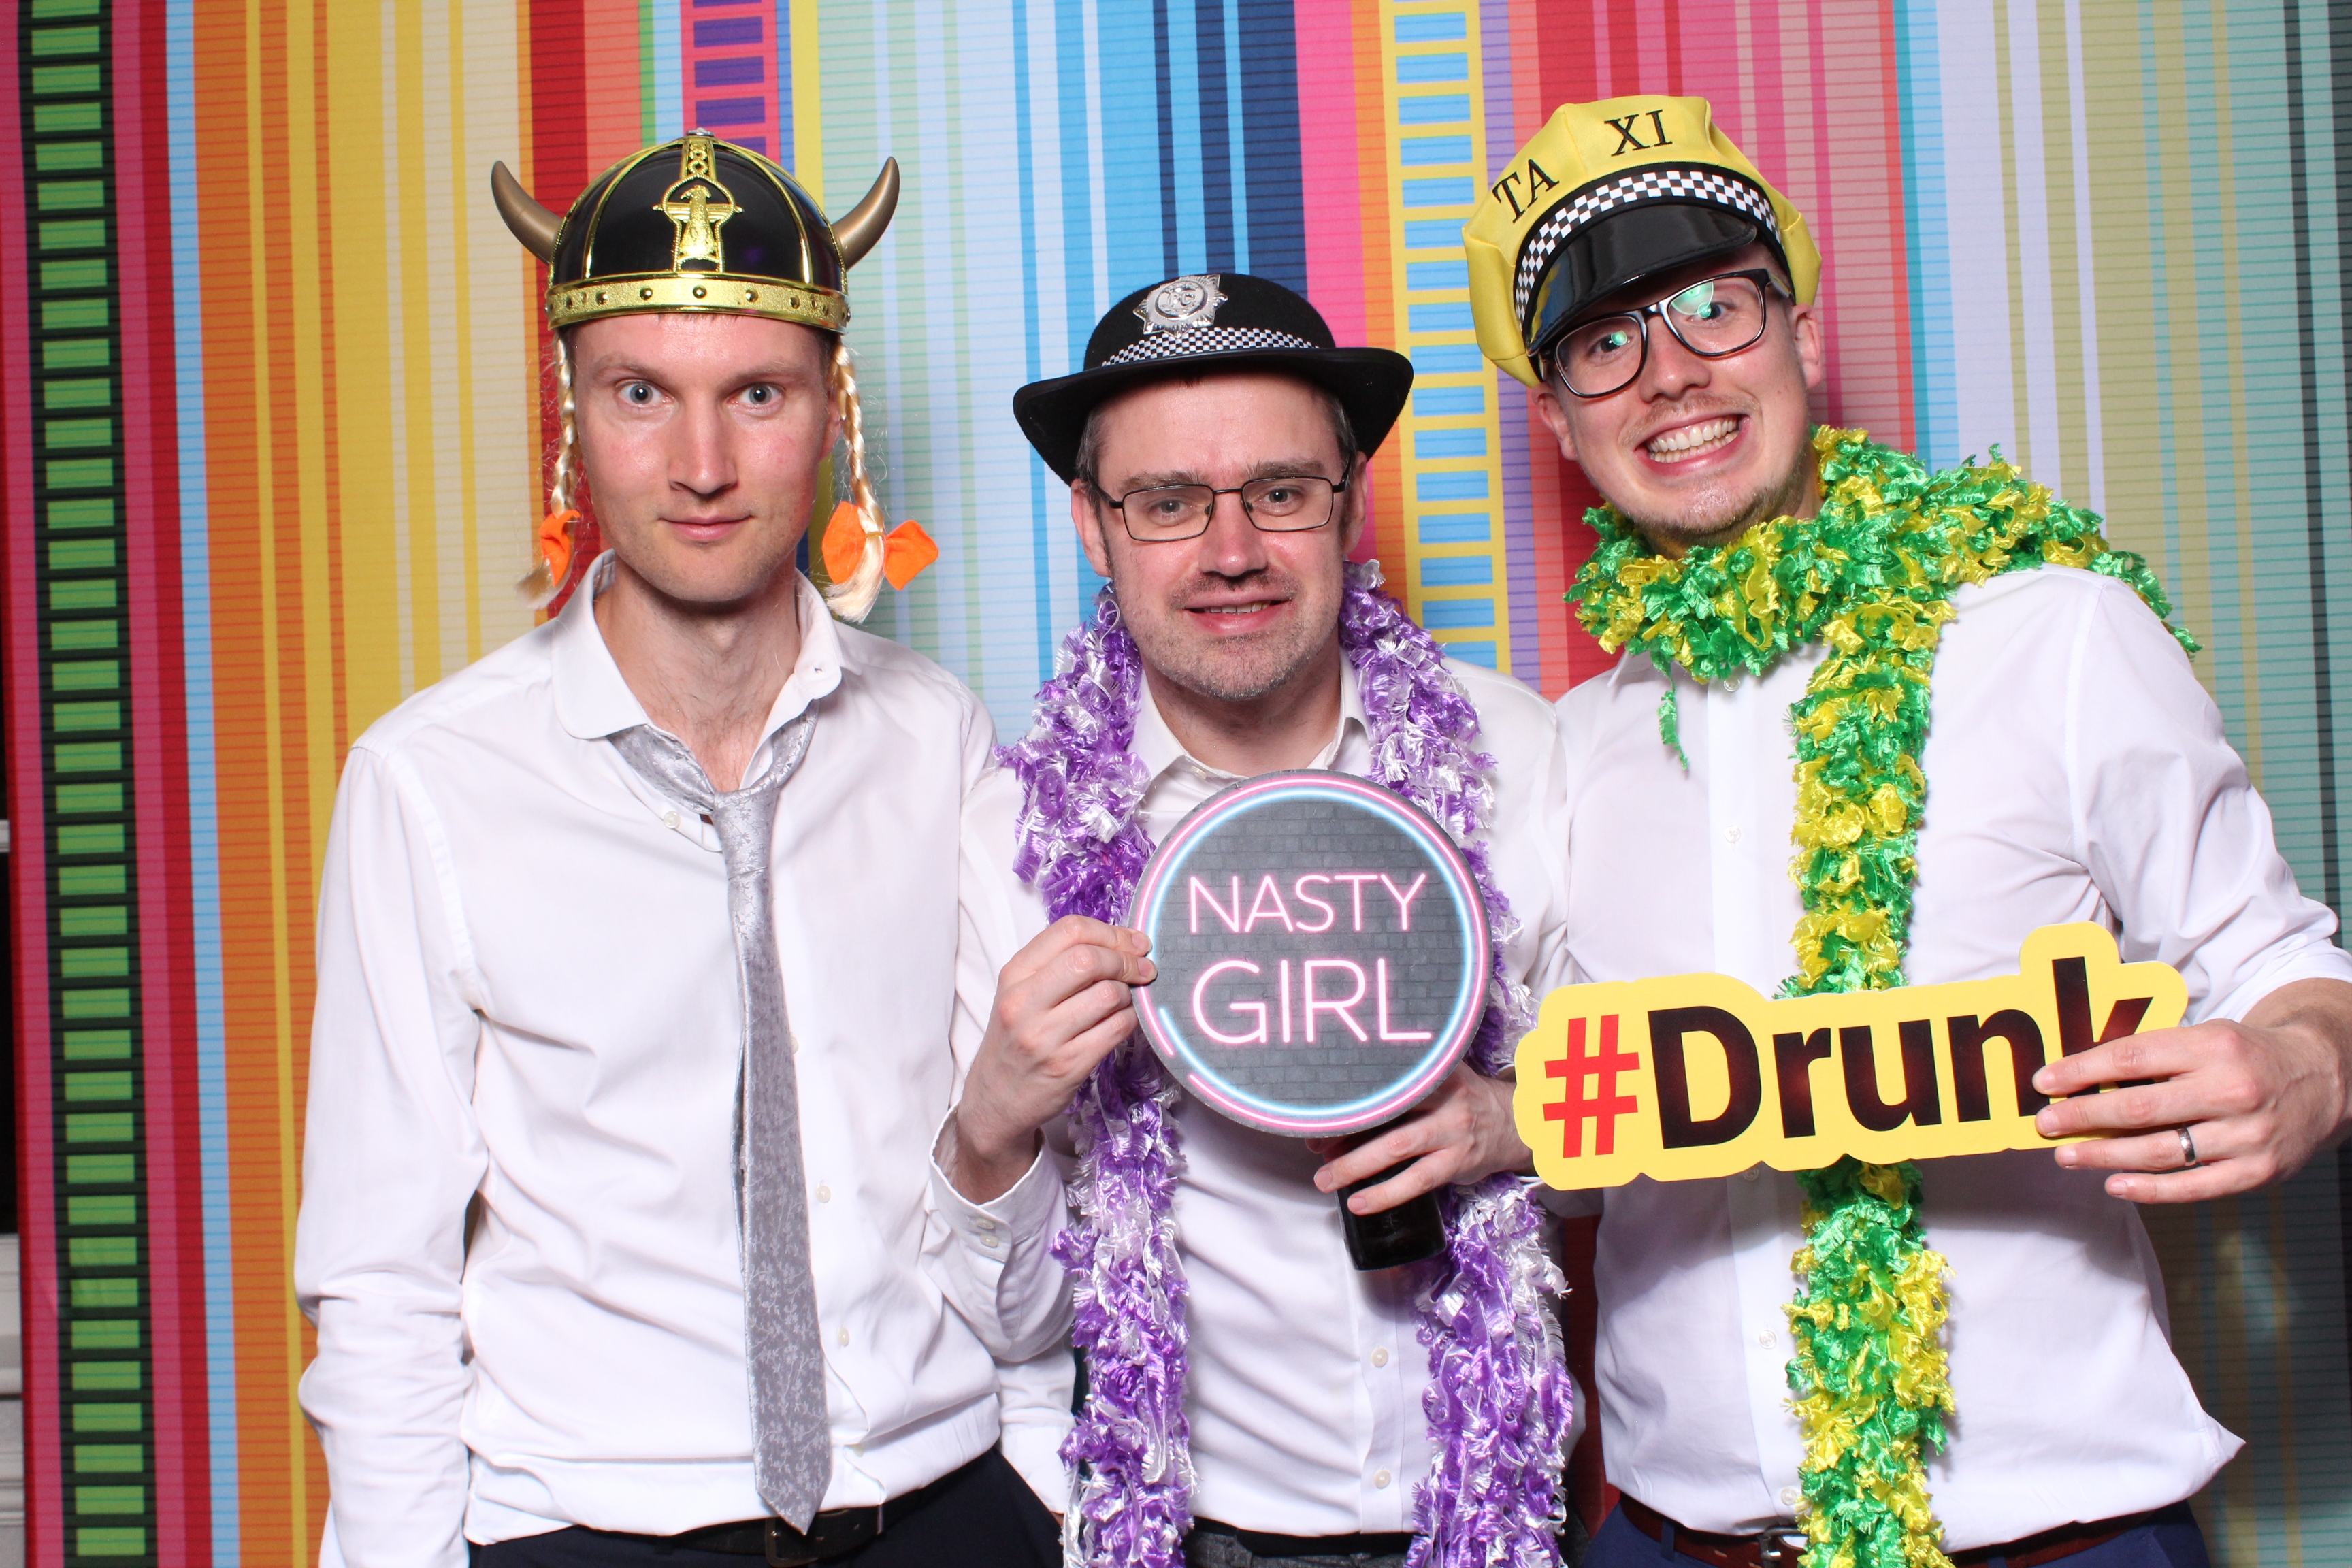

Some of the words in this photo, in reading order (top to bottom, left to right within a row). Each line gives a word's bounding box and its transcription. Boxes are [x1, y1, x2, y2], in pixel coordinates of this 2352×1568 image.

[1492, 159, 1559, 223] TA
[1604, 110, 1673, 157] XI
[1190, 872, 1426, 934] NASTY
[1191, 957, 1433, 1045] GIRL
[1544, 956, 2154, 1158] #Drunk
